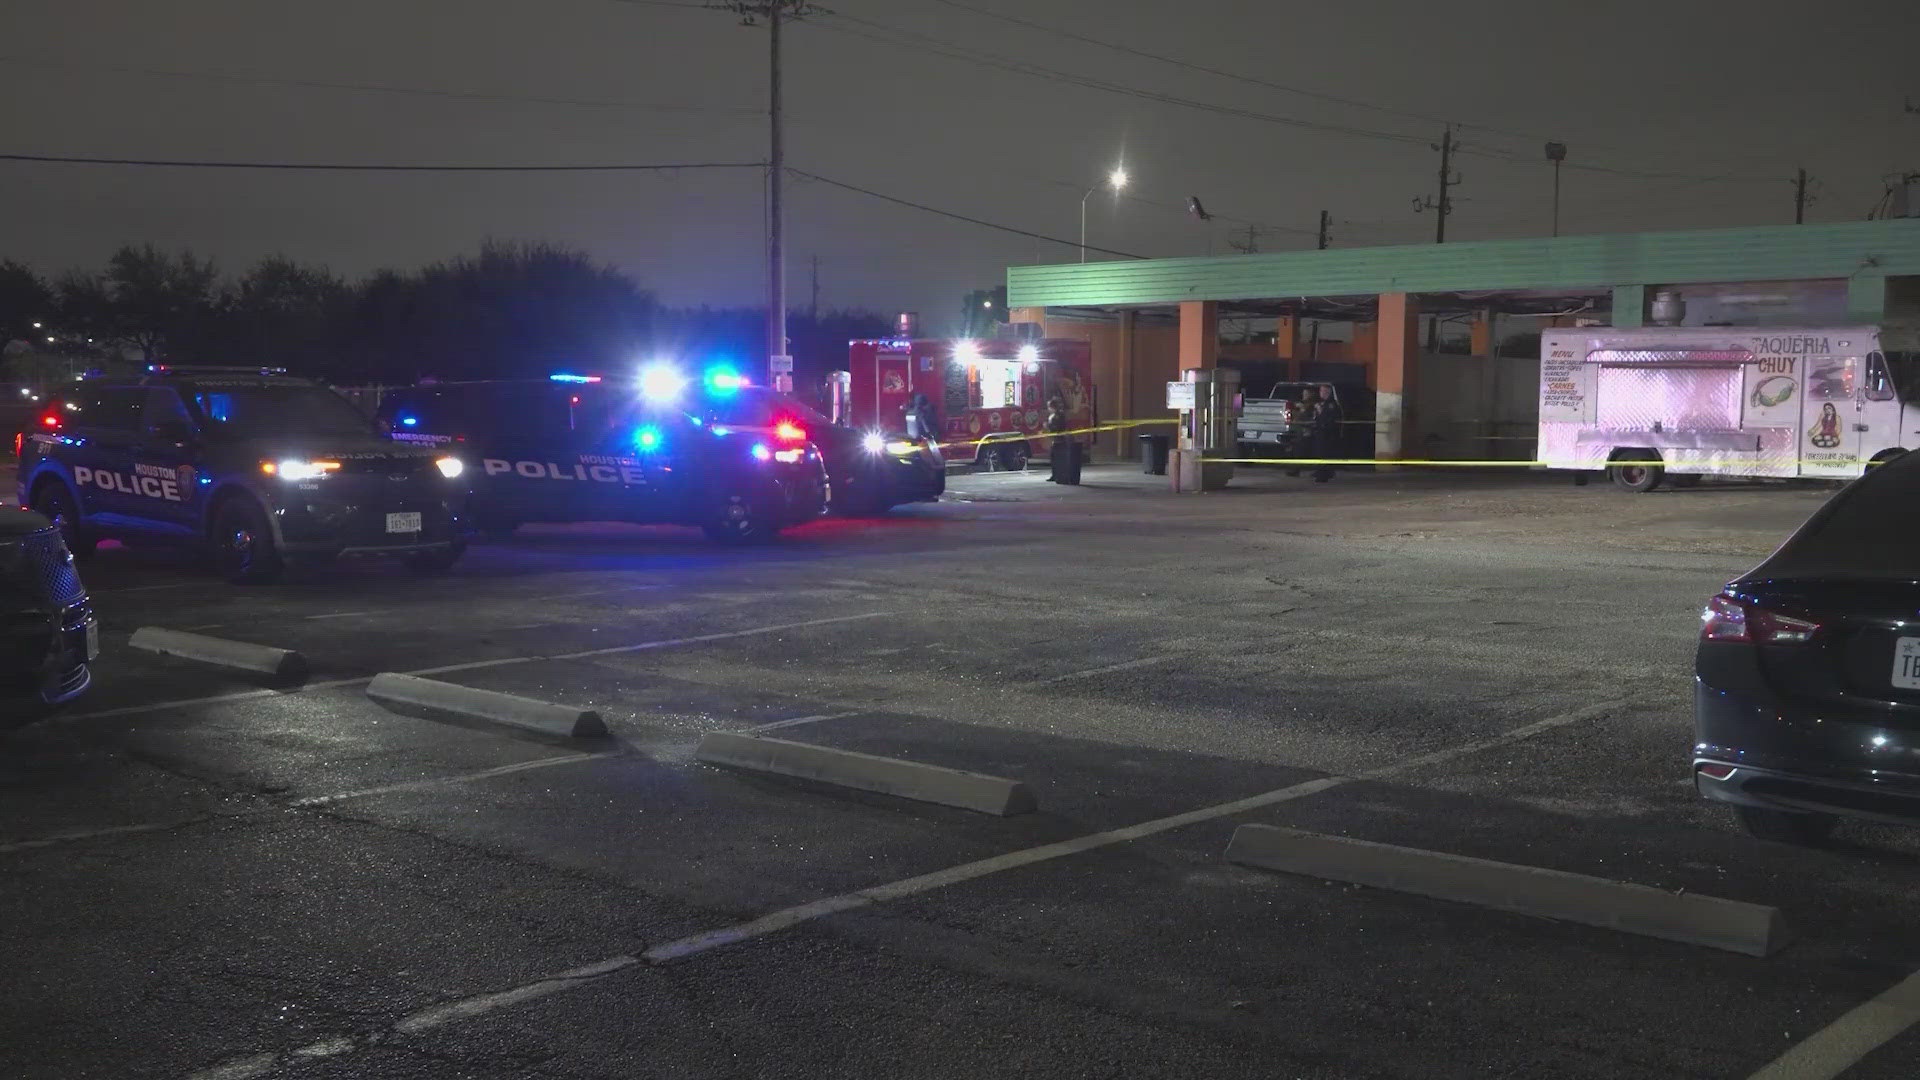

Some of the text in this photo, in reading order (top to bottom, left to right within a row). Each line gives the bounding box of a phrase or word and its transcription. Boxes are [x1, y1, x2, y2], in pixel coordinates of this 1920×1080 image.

[1752, 337, 1830, 354] TAQUERIA
[1758, 357, 1797, 373] CHUY
[391, 432, 452, 443] EMERGENCY
[579, 455, 641, 466] HOUSTON
[135, 463, 176, 479] HOUSTON
[483, 458, 648, 484] POLICE
[74, 465, 181, 502] POLICE
